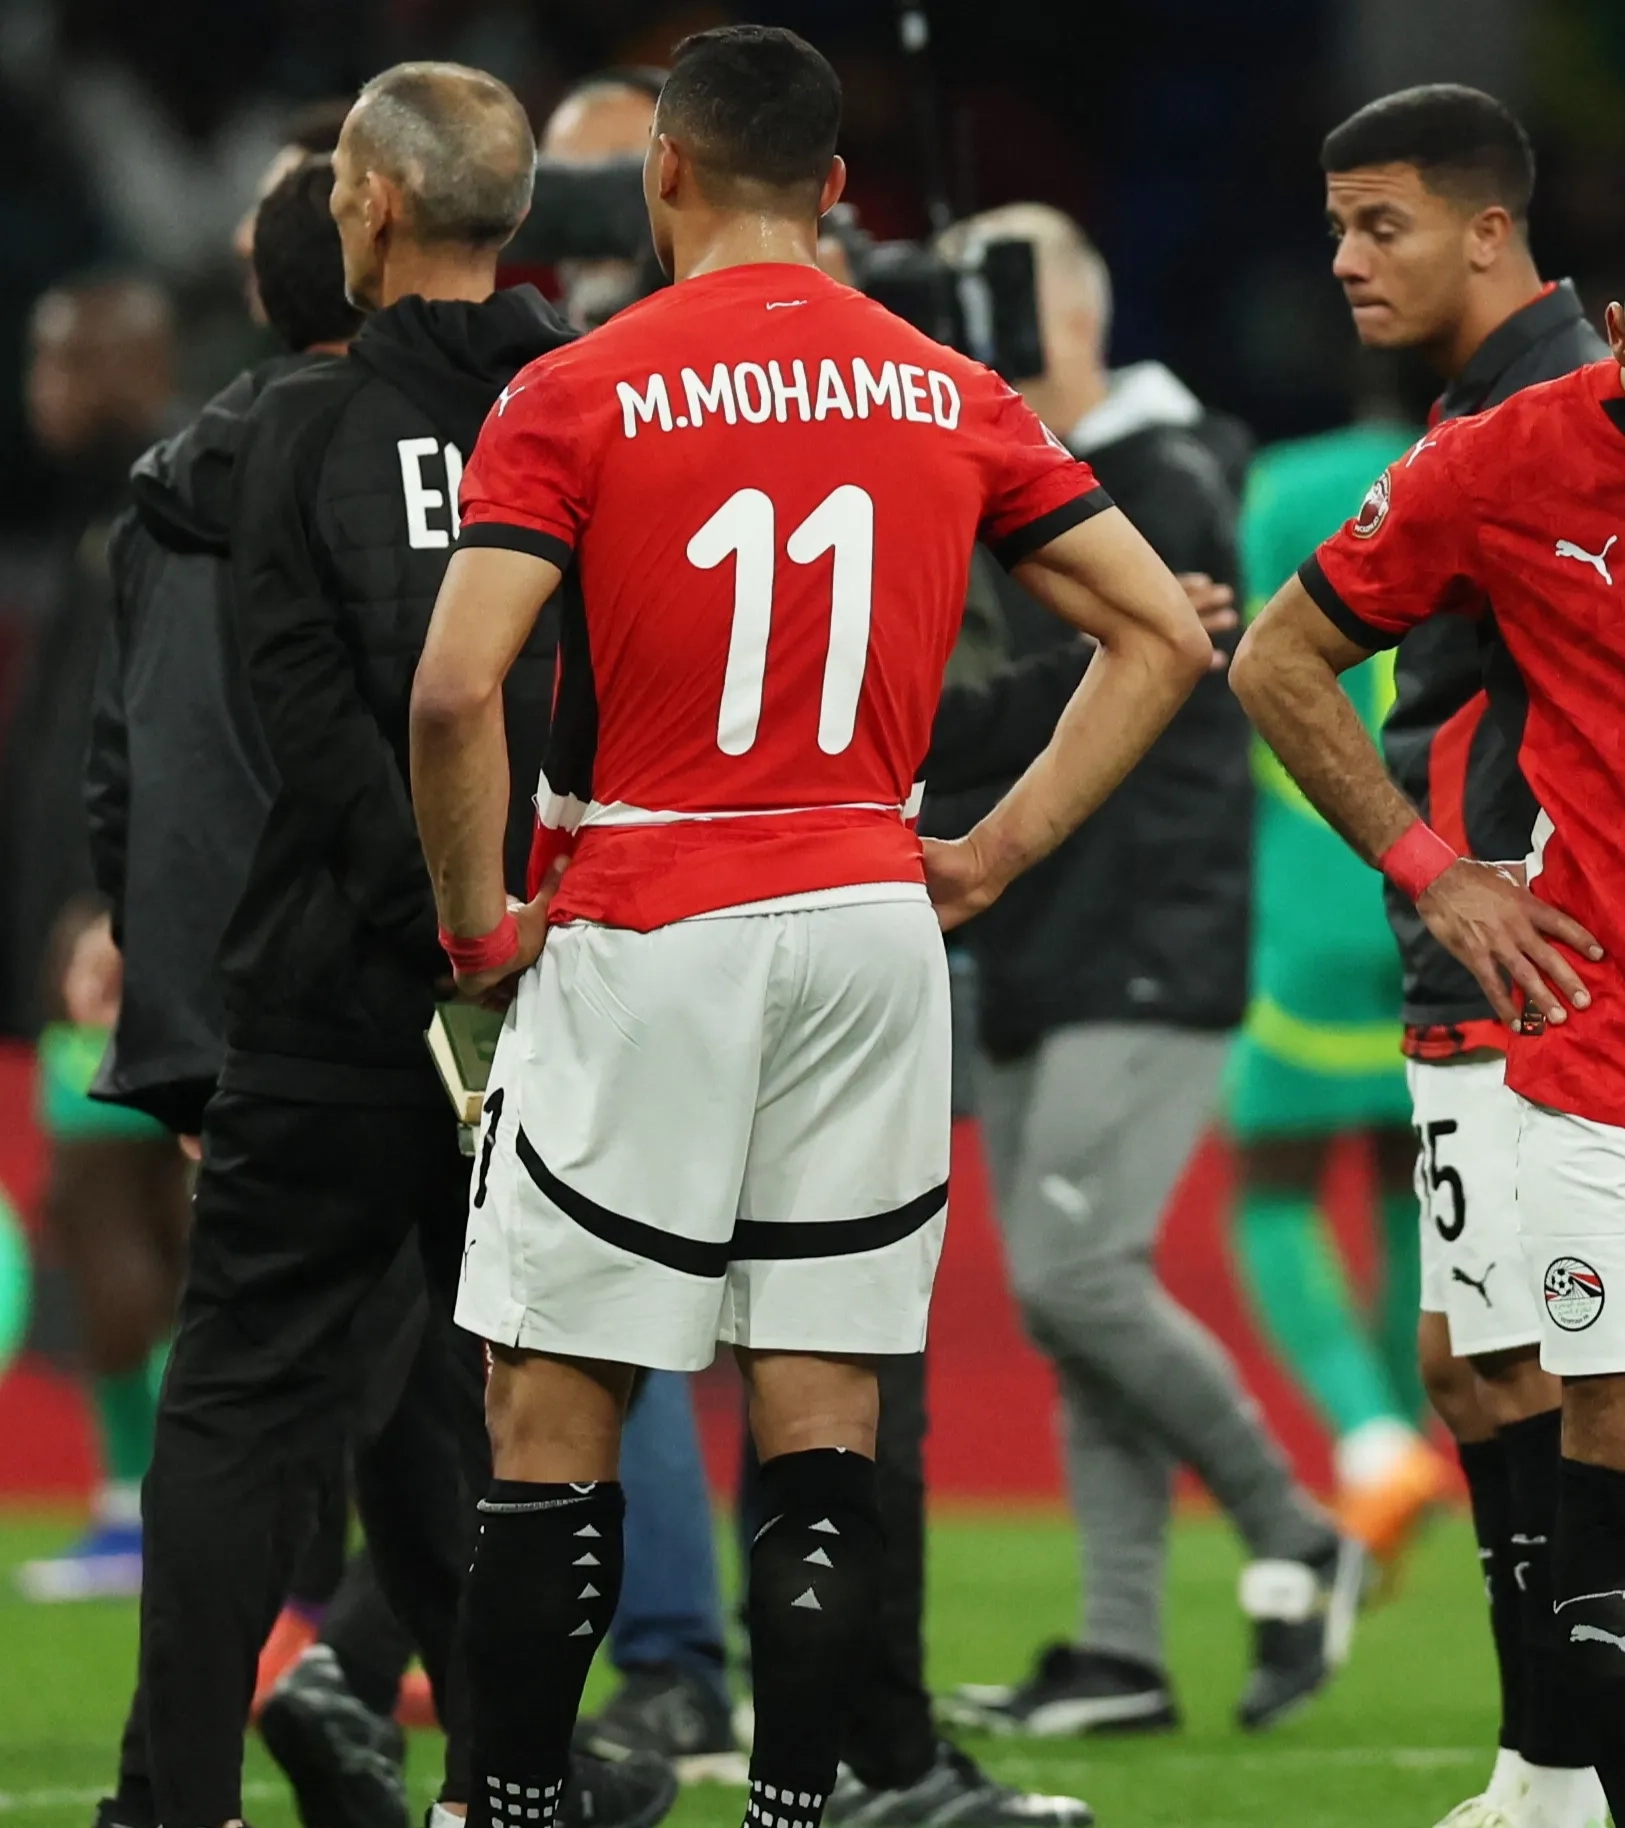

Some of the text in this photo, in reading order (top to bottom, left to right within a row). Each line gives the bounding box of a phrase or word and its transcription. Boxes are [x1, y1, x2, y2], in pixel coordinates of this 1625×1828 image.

[616, 357, 961, 439] M.MOHAMED
[686, 484, 874, 756] 11
[1417, 1119, 1466, 1242] 5
